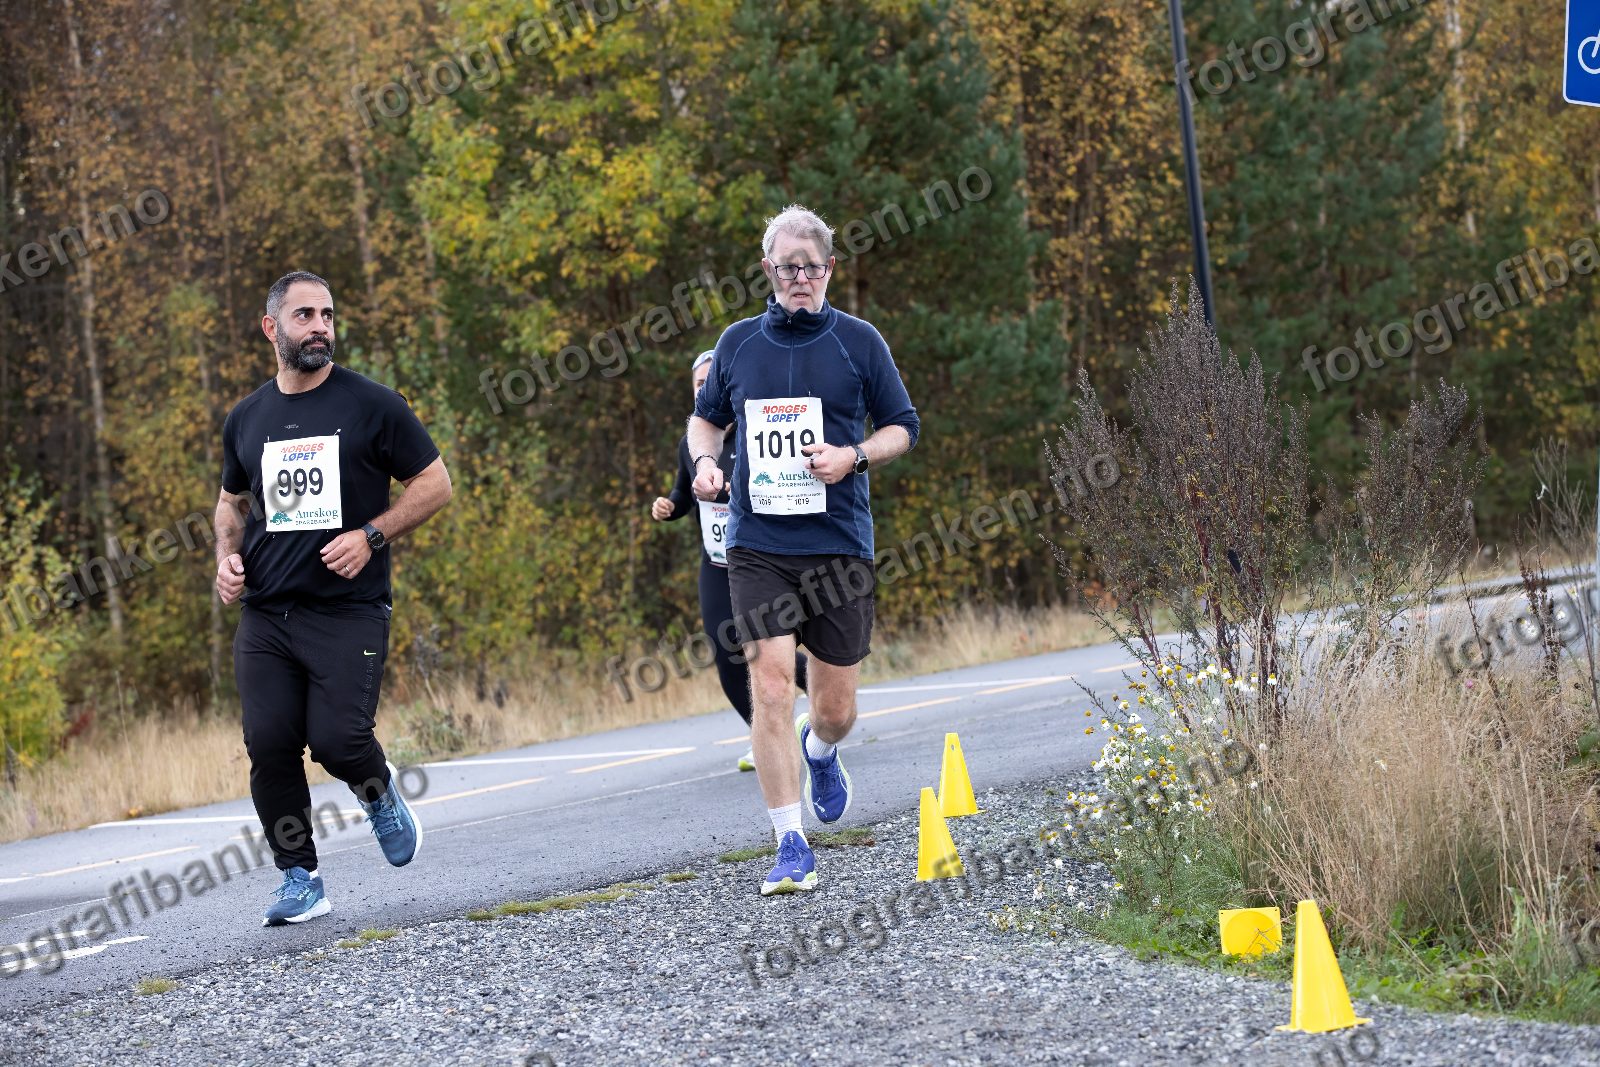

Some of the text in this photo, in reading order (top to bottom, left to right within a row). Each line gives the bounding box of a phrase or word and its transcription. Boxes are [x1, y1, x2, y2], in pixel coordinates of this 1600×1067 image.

[762, 404, 808, 414] NORGES
[766, 413, 800, 423] LØPET
[280, 442, 325, 454] NORGES
[754, 428, 816, 459] 1019
[282, 451, 318, 462] LØPET
[277, 467, 324, 498] 999
[295, 507, 339, 519] Aurskog
